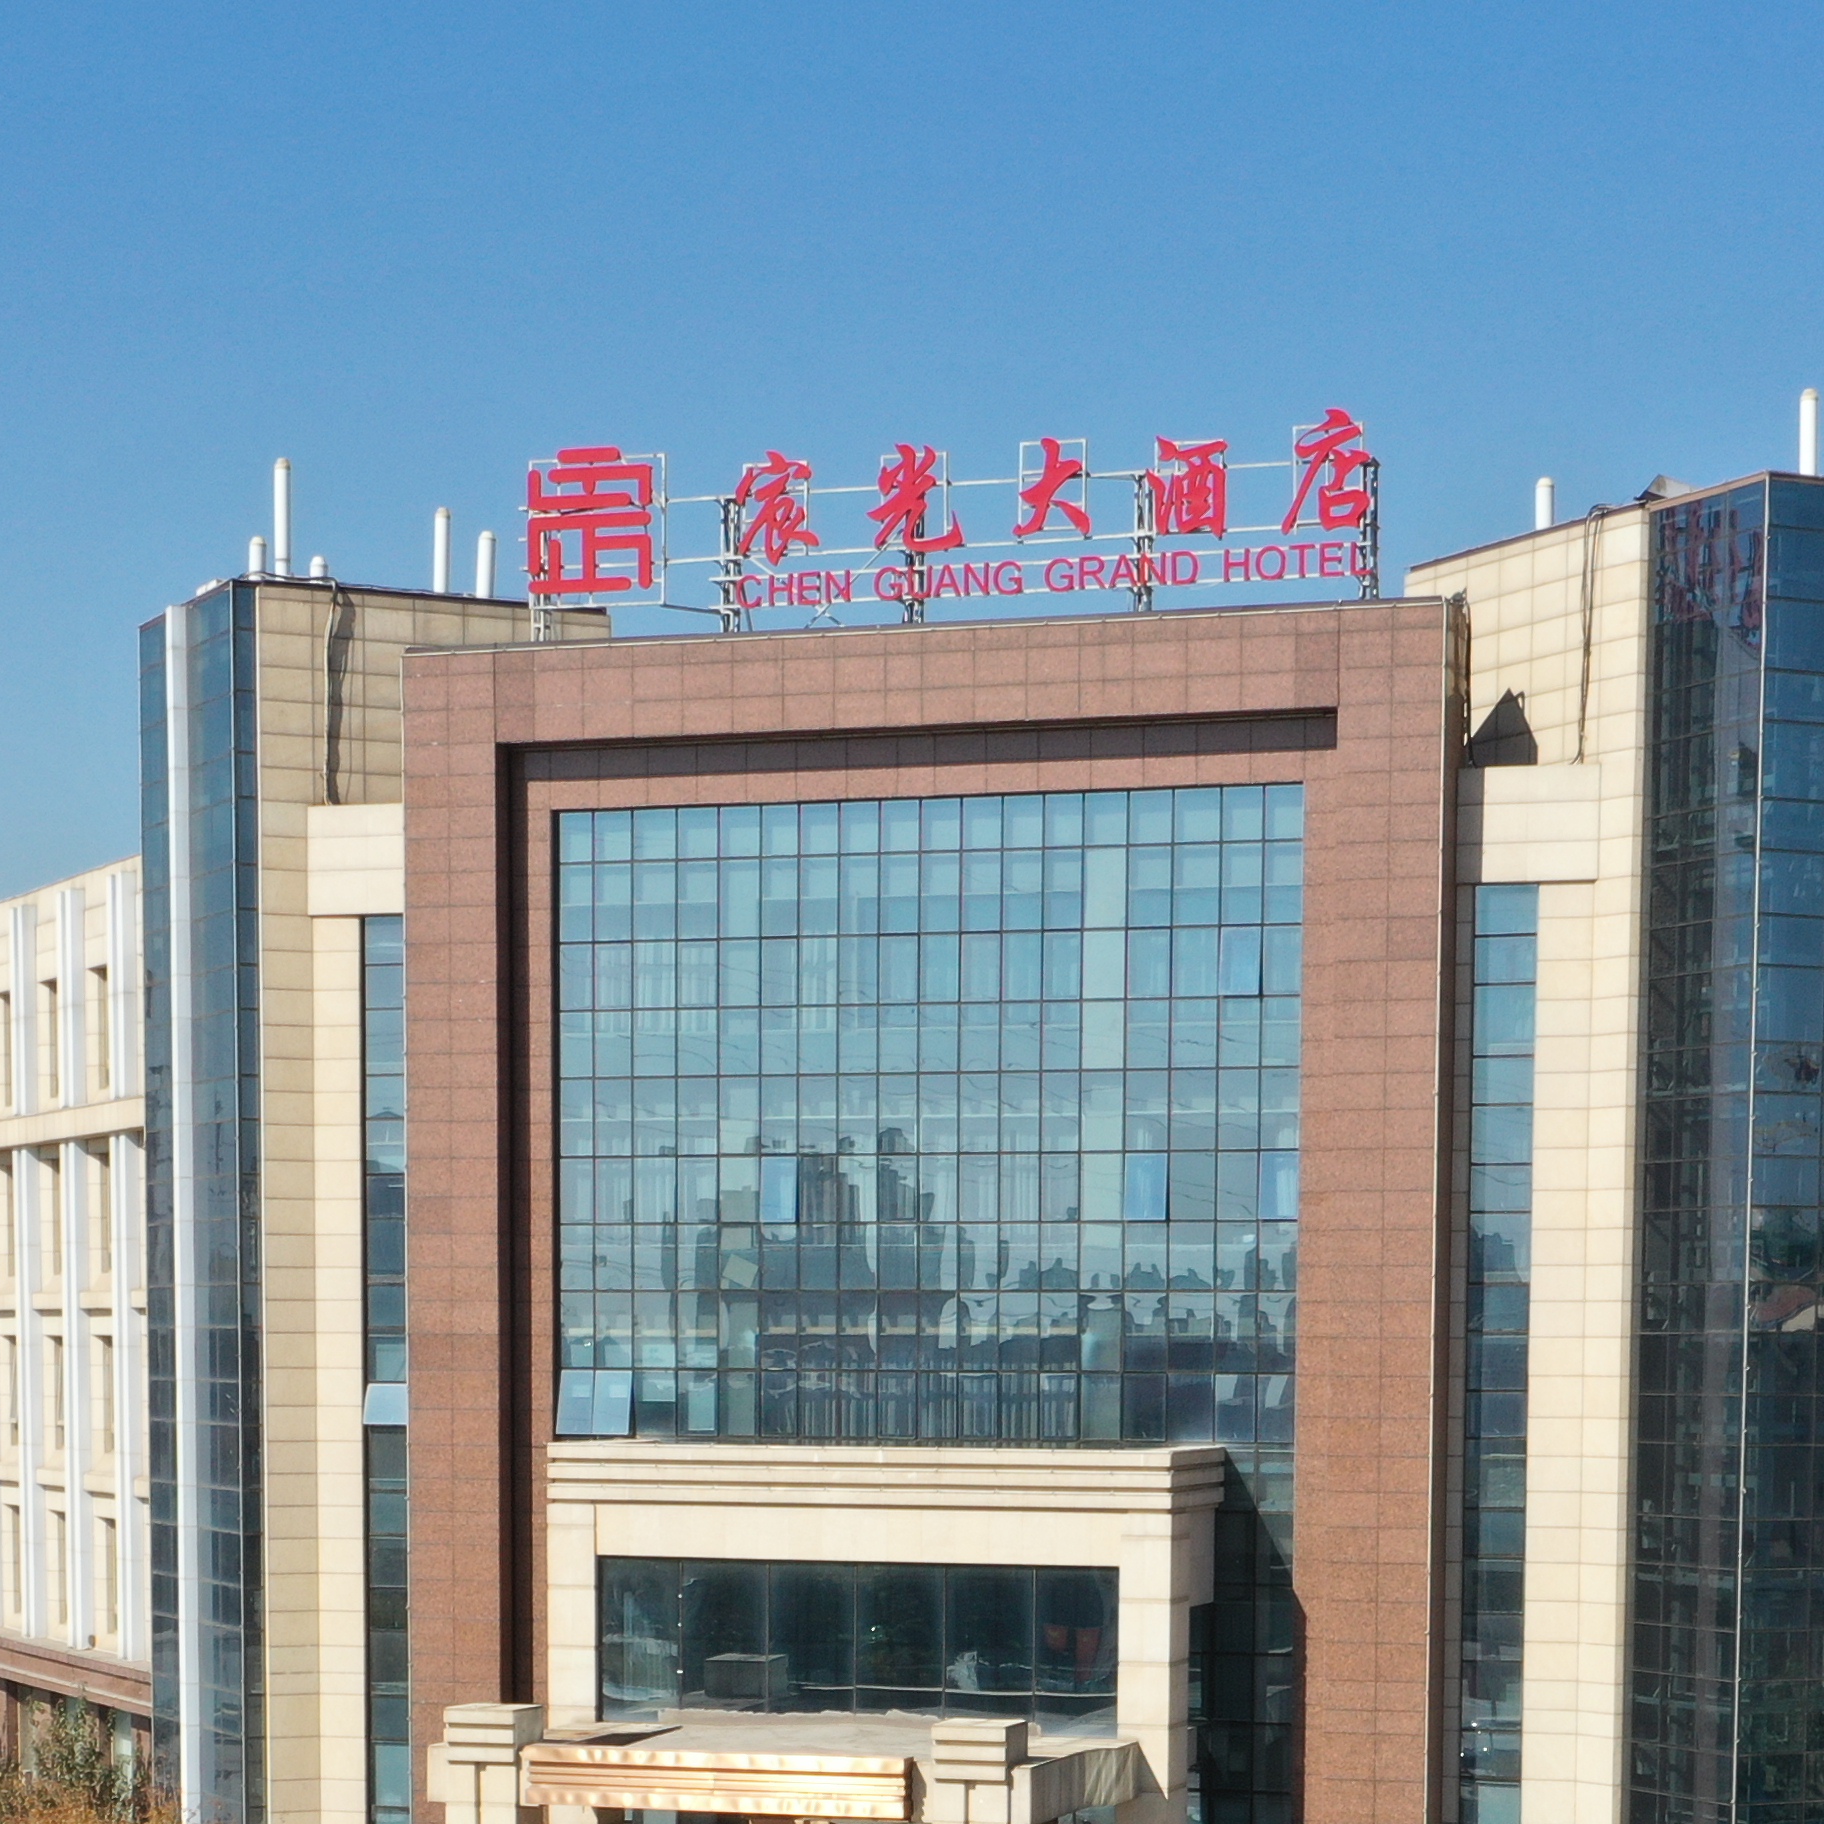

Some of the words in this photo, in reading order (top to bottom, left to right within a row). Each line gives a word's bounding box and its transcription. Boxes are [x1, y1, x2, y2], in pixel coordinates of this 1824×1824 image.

[735, 407, 1373, 566] 宸光大酒店
[735, 570, 853, 609] CHEN
[874, 560, 1024, 602] GUANG
[1044, 550, 1201, 592] GRAND
[1223, 541, 1373, 582] HOTEL
